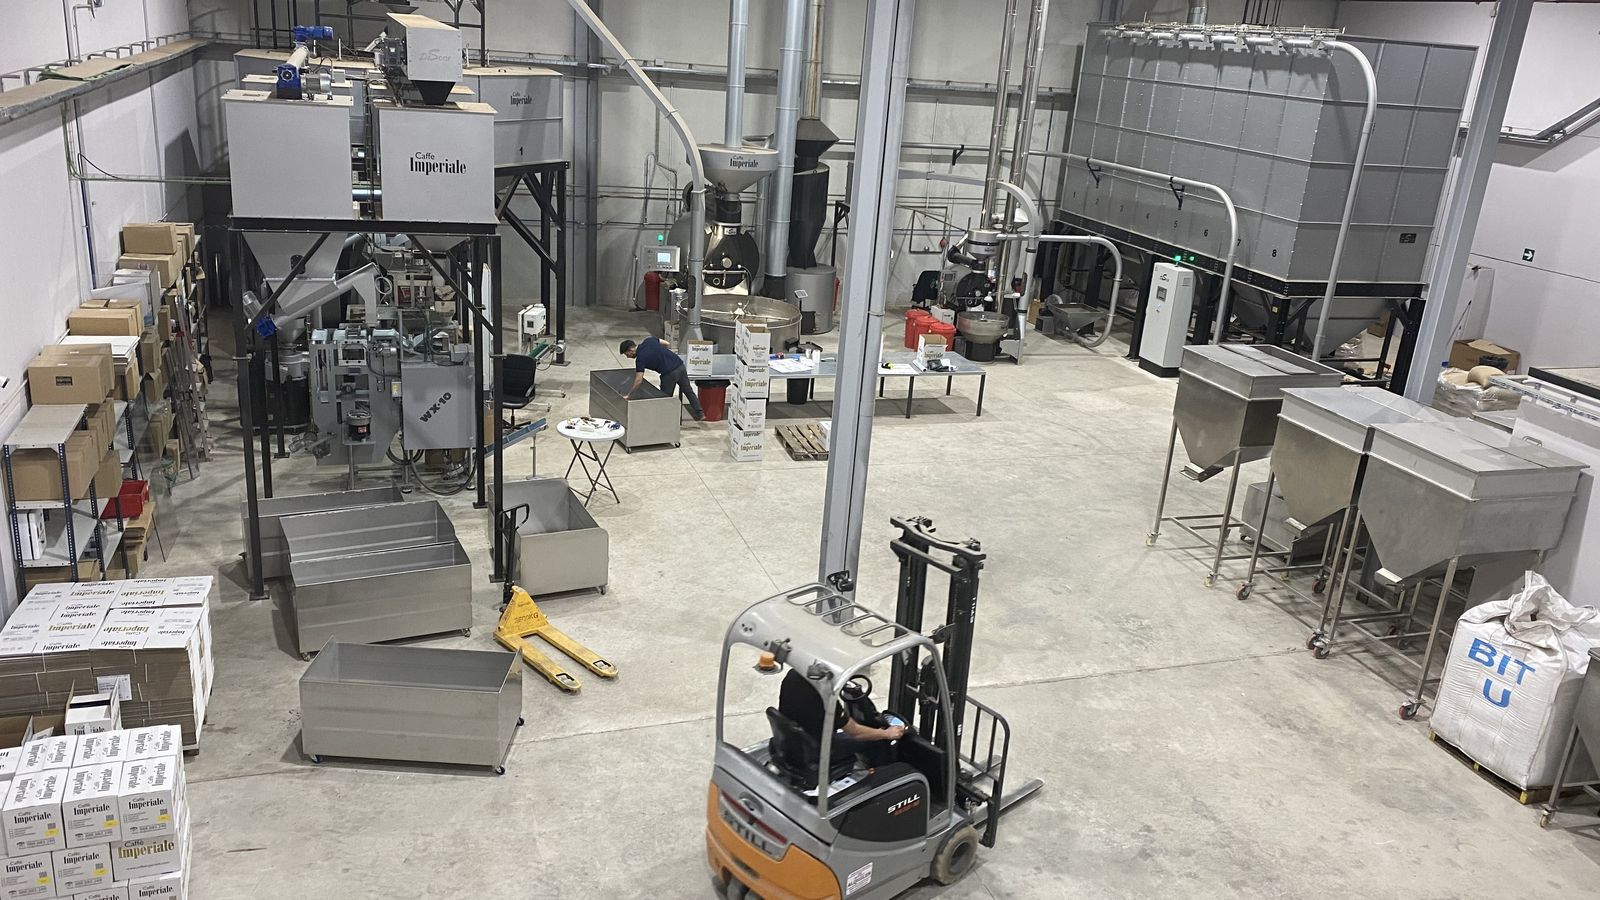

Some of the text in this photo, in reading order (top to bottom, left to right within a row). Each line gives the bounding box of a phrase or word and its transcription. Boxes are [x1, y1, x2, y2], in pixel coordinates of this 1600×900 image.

[510, 96, 532, 107] Imperiale
[519, 146, 523, 155] 1
[410, 157, 466, 175] Imperiale
[730, 158, 758, 168] Imperiale
[1174, 220, 1177, 228] 5
[1204, 229, 1208, 237] 6
[1272, 249, 1277, 257] 8
[48, 623, 96, 631] Imperiale
[43, 643, 80, 651] Imperiale
[1467, 638, 1536, 685] BIT
[1483, 678, 1512, 708] U
[129, 798, 164, 810] Imperiale
[888, 794, 920, 814] STILL
[74, 804, 110, 816] Imperiale
[14, 812, 52, 824] Imperiale
[725, 810, 772, 855] STILL
[118, 840, 174, 859] Imperiale
[64, 853, 99, 864] Imperiale
[6, 861, 43, 872] Imperiale
[139, 886, 173, 897] Imperiale
